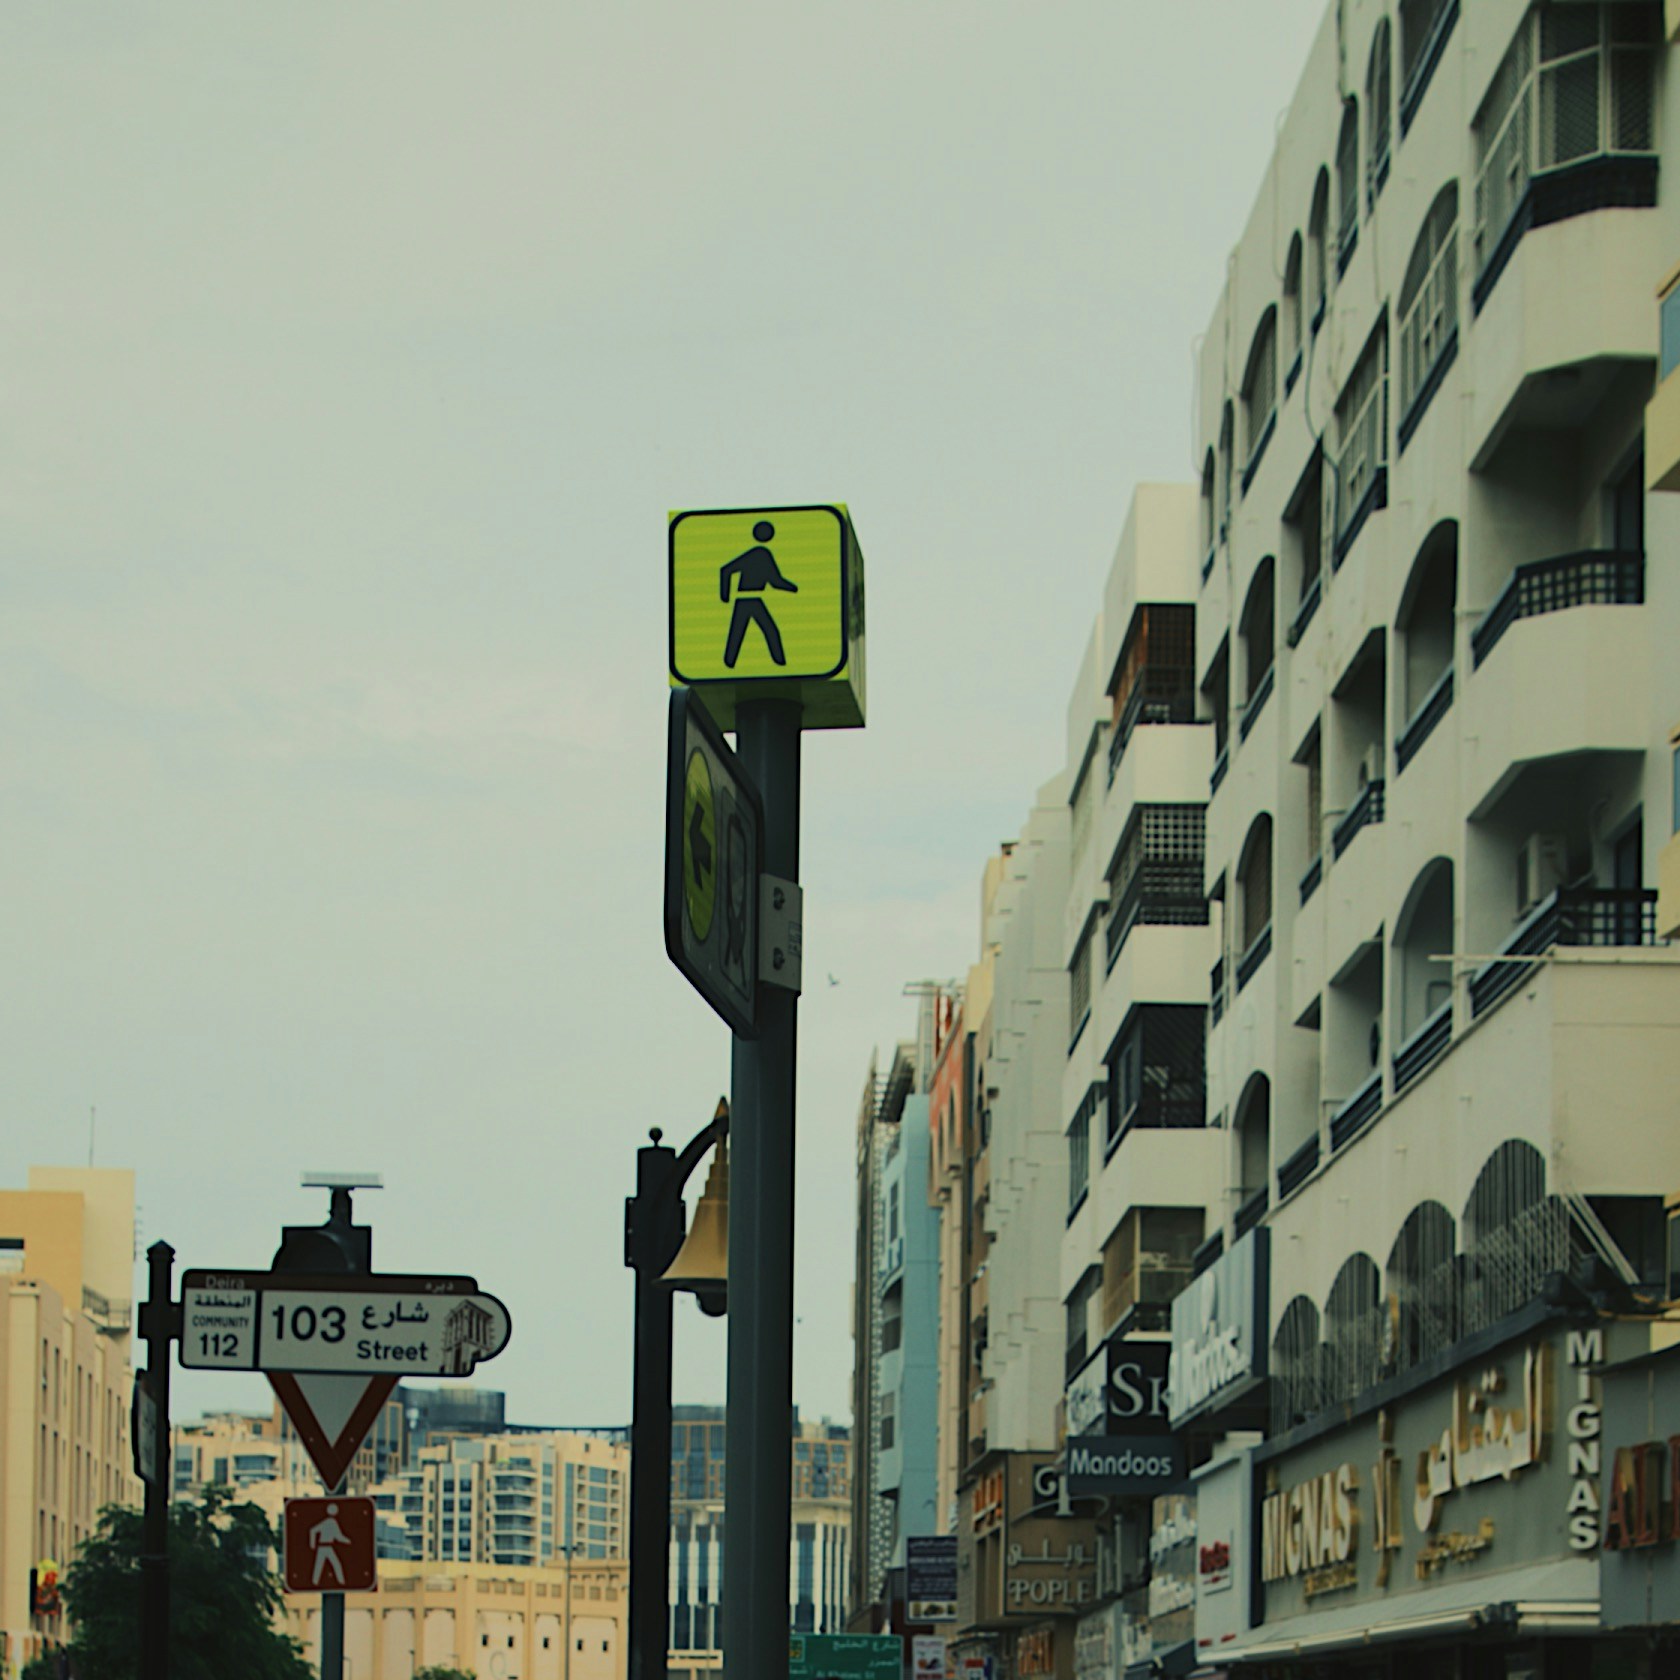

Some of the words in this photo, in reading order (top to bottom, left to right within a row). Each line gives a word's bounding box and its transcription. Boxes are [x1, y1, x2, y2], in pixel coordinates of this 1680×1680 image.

[205, 1273, 245, 1288] Deira
[192, 1314, 249, 1328] COMMUNITY
[272, 1305, 345, 1342] 103
[361, 1301, 428, 1329] شارع
[200, 1334, 237, 1356] 112
[357, 1340, 428, 1361] Street
[1566, 1330, 1602, 1551] MIGNAS
[1070, 1449, 1172, 1476] Mandoos
[1604, 1441, 1667, 1551] AL
